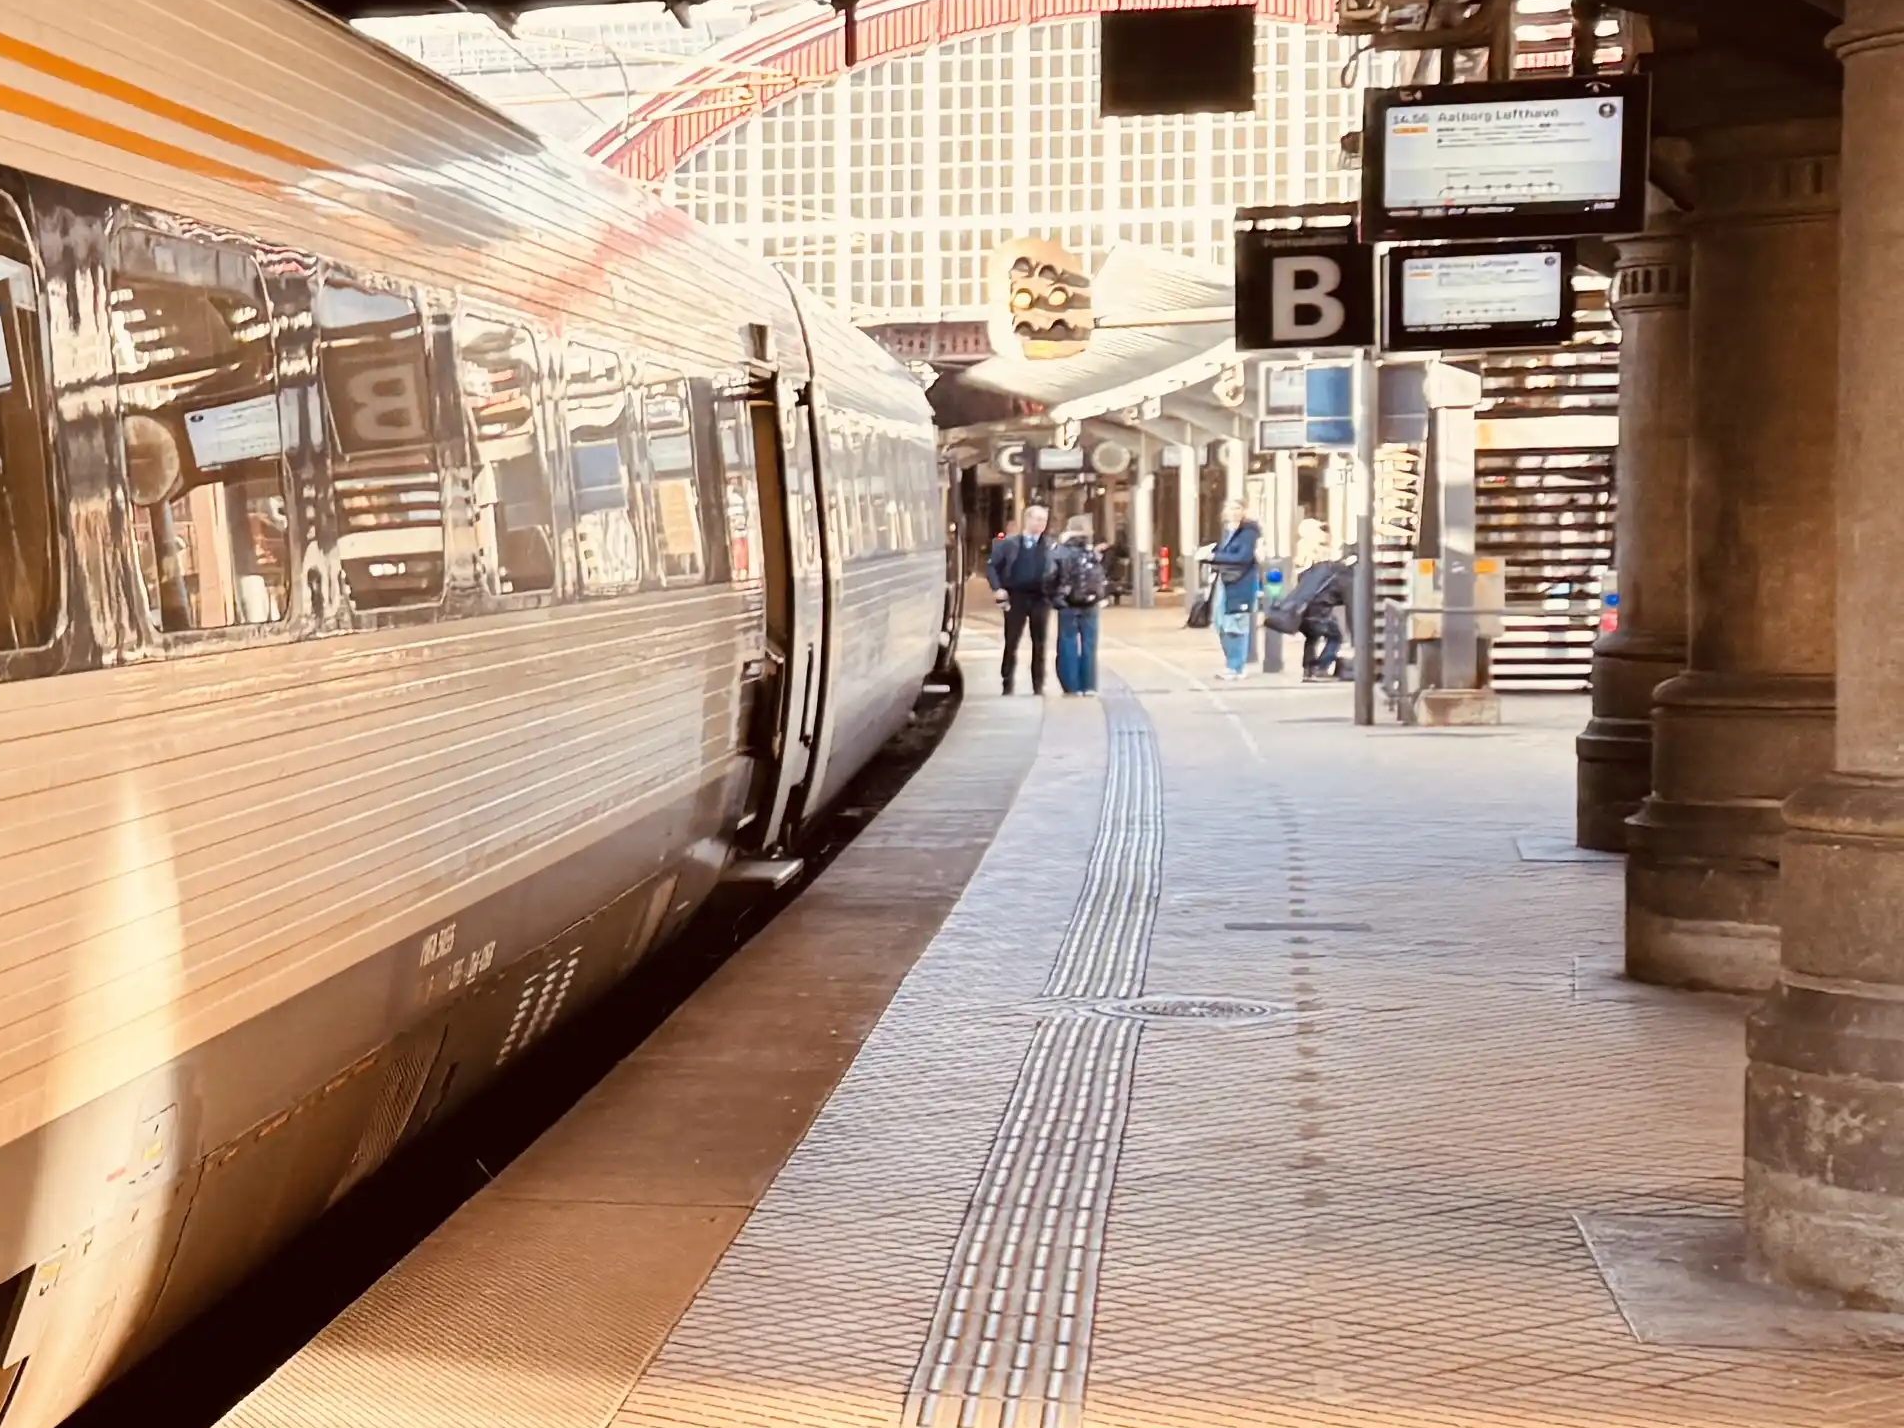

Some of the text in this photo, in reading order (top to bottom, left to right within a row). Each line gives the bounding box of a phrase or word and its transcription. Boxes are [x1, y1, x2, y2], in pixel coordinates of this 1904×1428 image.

[1438, 112, 1491, 123] Aalborg
[1496, 109, 1559, 120] Lufthavn
[1271, 255, 1345, 342] B
[1000, 446, 1024, 473] C
